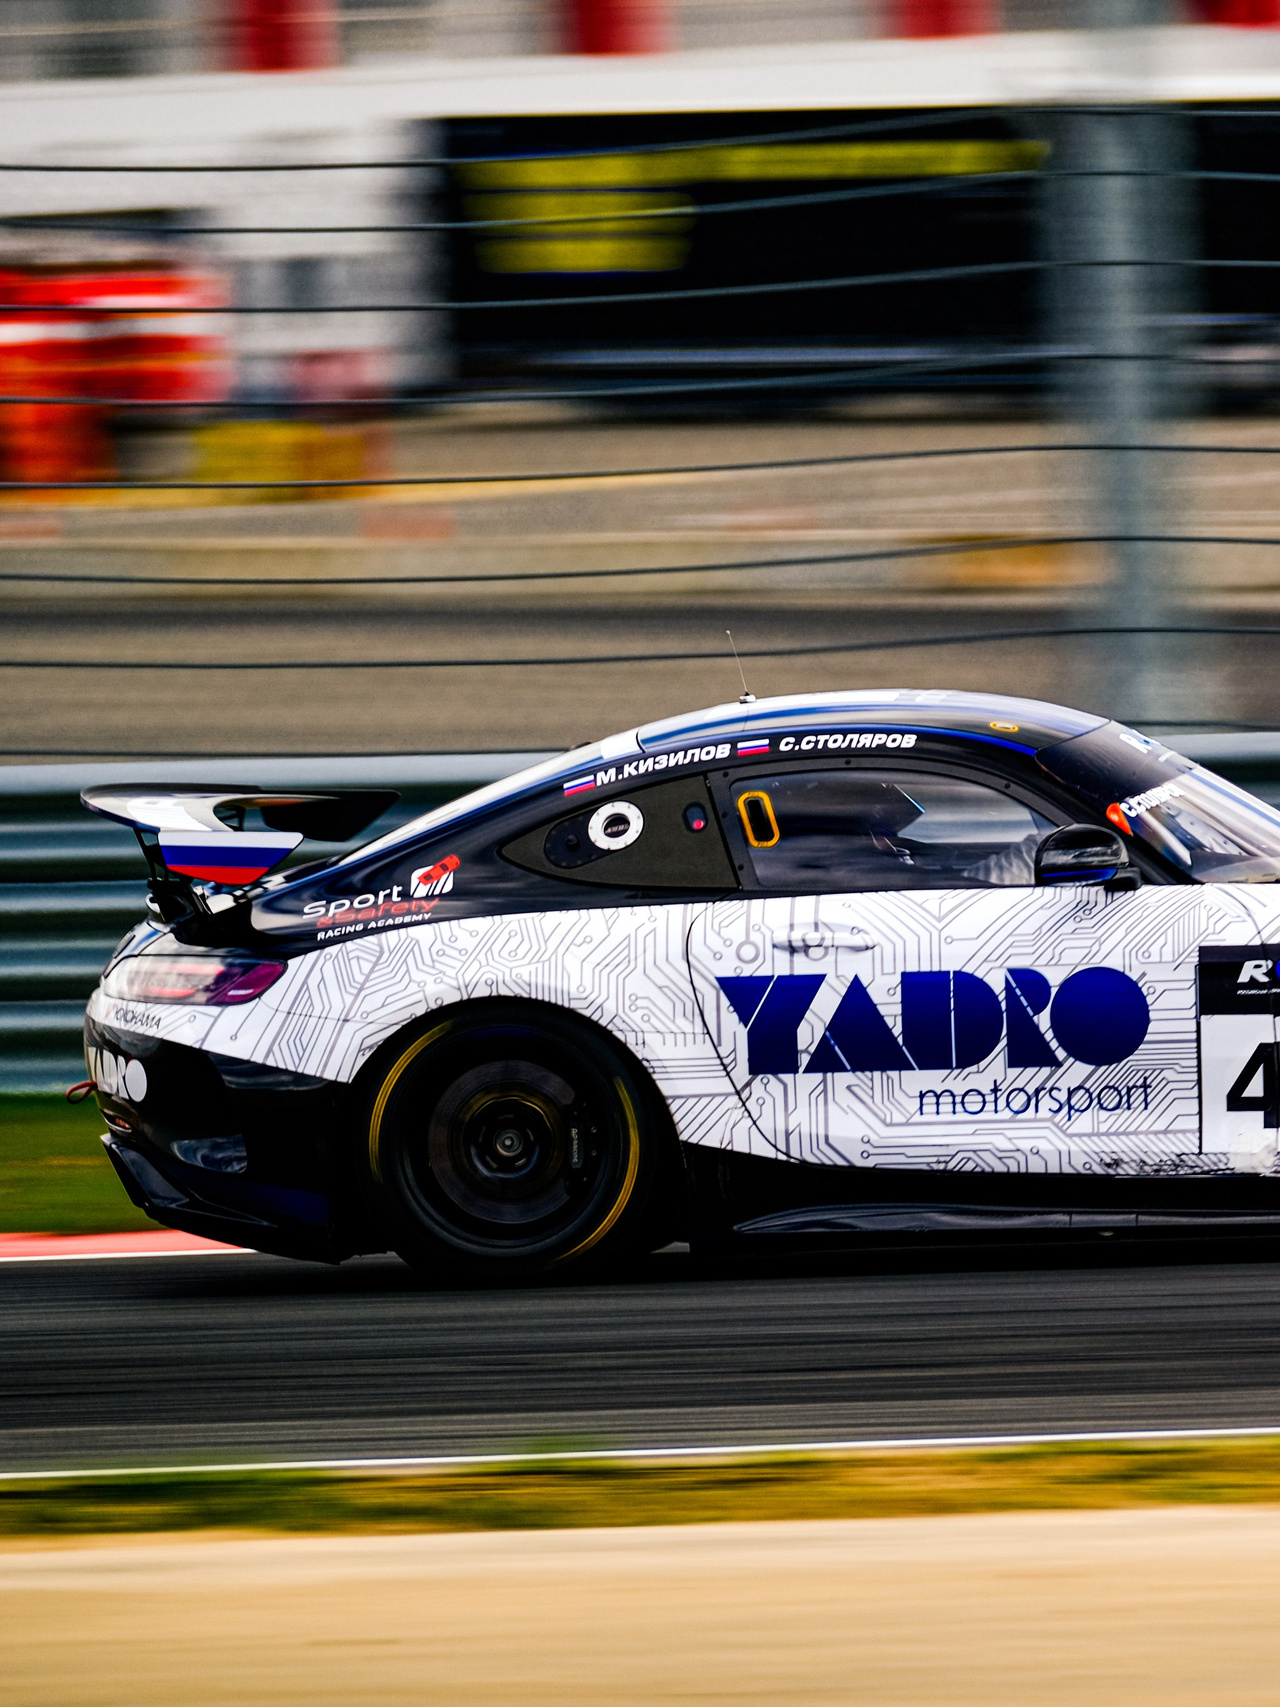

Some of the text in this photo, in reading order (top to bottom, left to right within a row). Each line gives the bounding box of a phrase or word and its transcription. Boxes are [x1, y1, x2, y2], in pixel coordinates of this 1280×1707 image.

[779, 733, 918, 752] С.СТОЛЯРОВ
[596, 743, 732, 787] М.КИЗИЛОВ
[302, 884, 403, 919] Sport
[316, 912, 432, 942] RACING ACADEMY
[714, 966, 1150, 1076] YADRO
[918, 1077, 1153, 1122] motorsport
